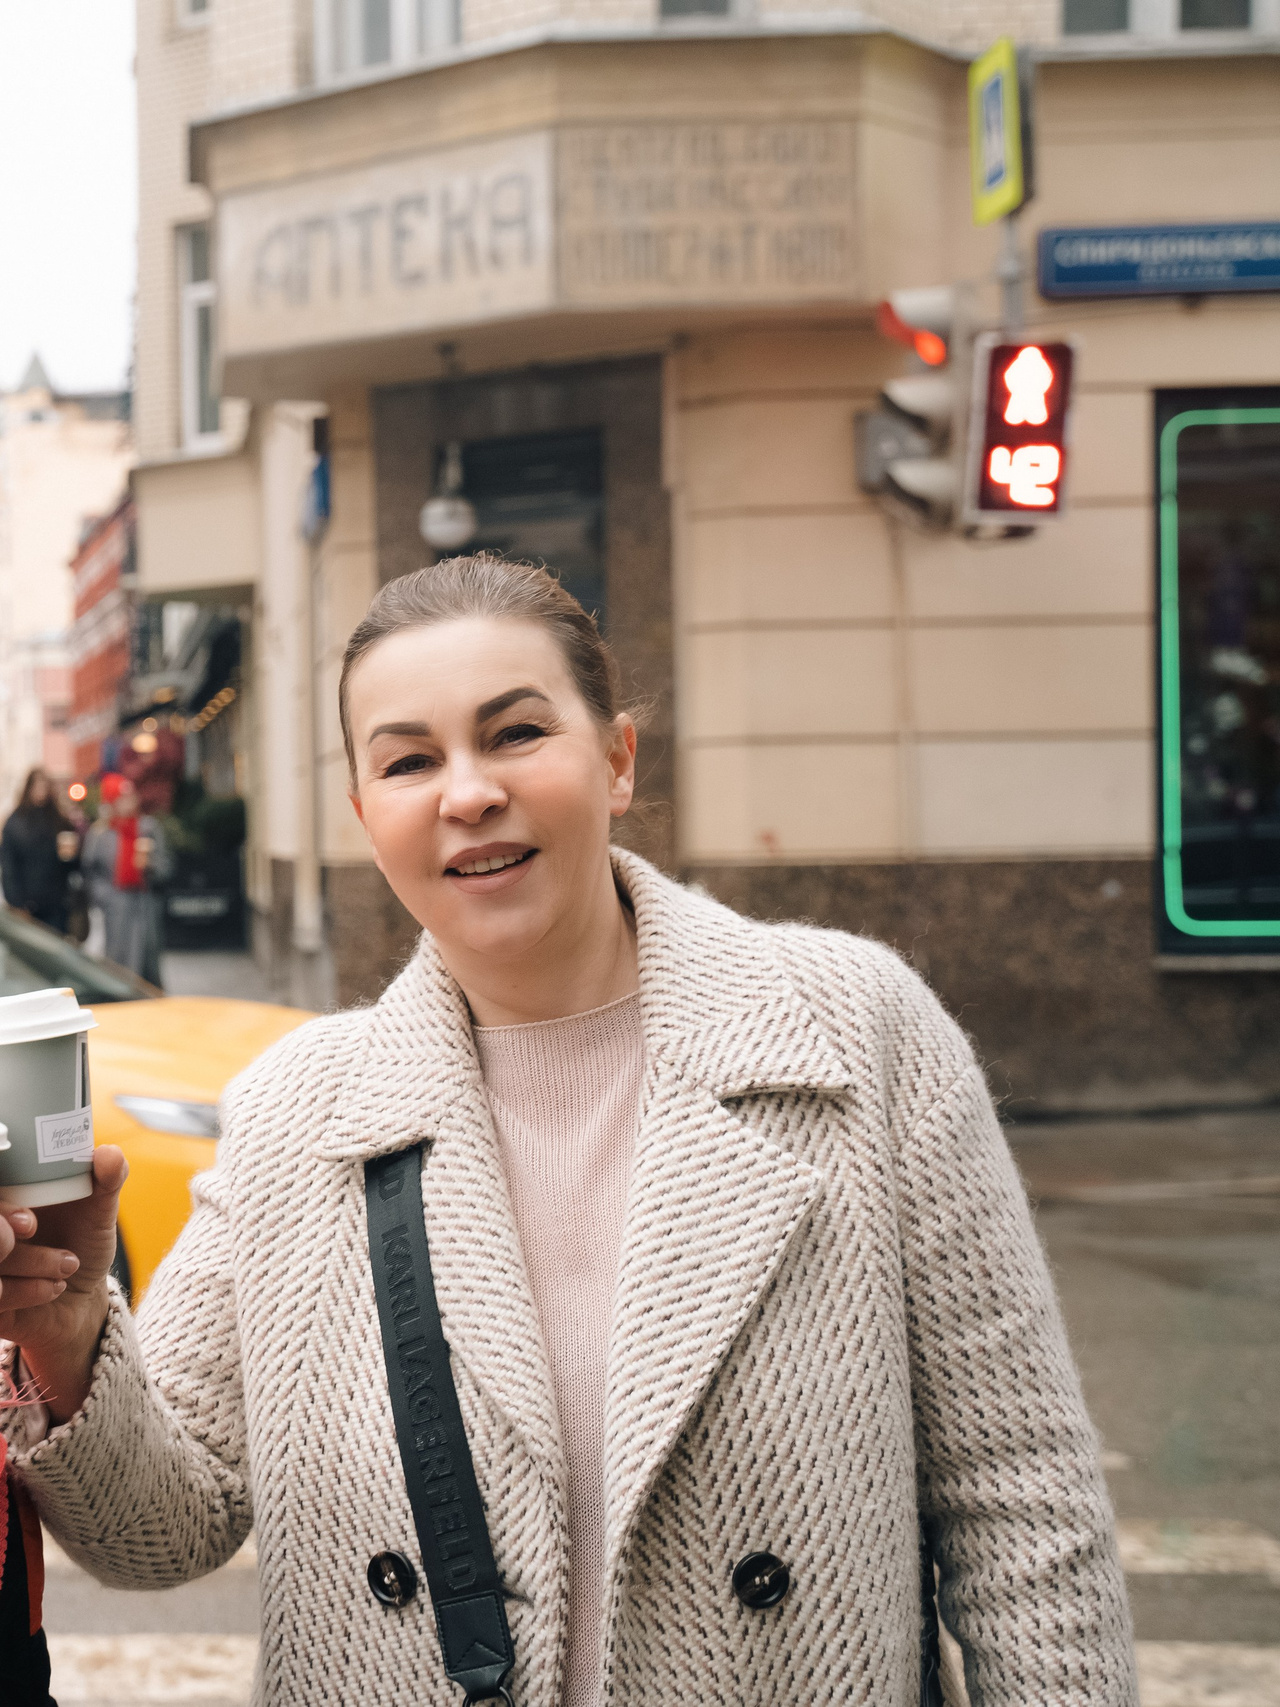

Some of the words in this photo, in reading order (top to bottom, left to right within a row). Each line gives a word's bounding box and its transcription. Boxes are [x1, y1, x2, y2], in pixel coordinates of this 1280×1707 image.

[248, 172, 533, 309] АПТЕКА
[380, 1222, 422, 1341] KARL
[396, 1335, 478, 1591] LAGERFELD
